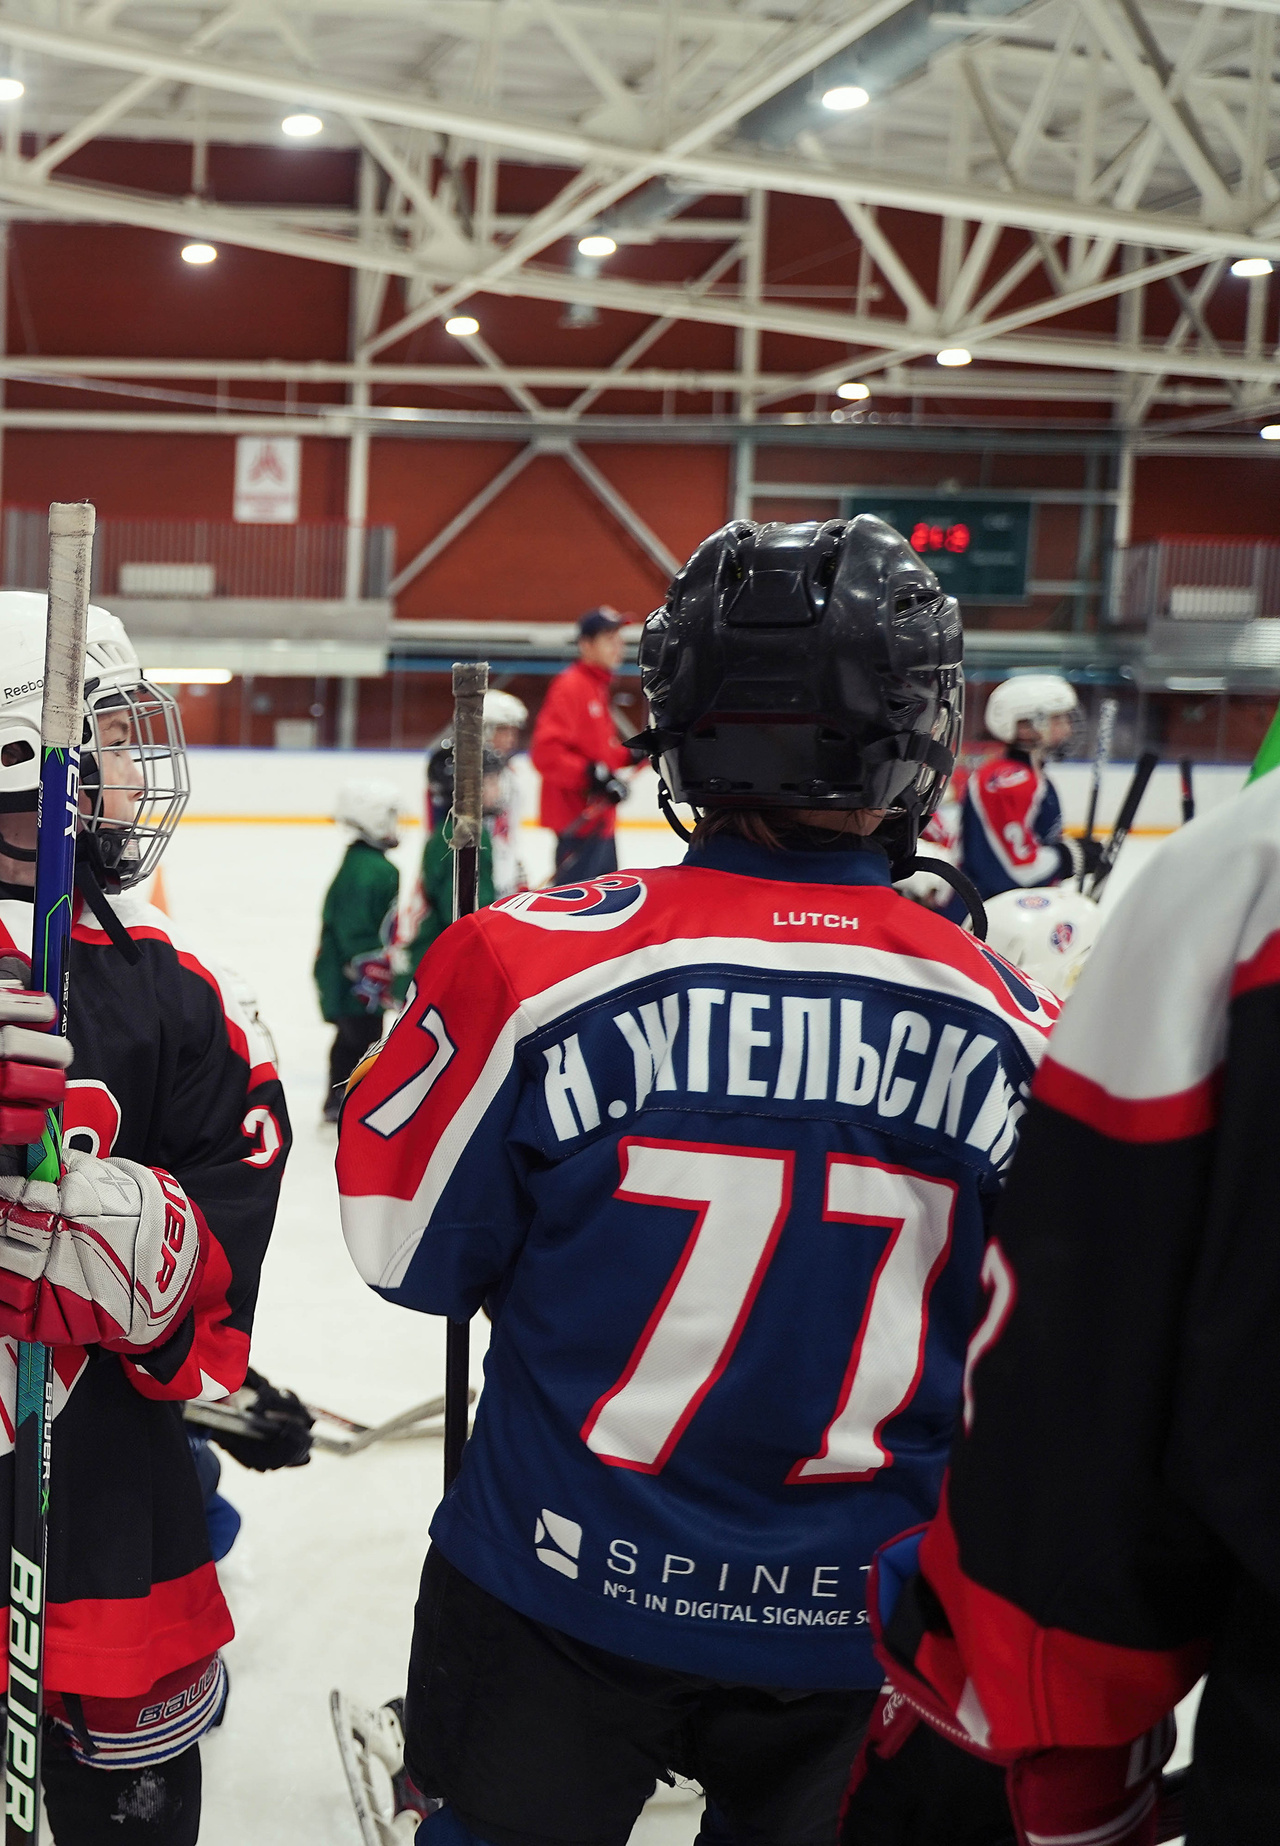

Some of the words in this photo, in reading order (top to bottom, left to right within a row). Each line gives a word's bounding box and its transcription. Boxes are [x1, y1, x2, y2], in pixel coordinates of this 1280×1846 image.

[4, 678, 44, 699] Reebo
[773, 911, 859, 930] LUTCH
[542, 987, 1028, 1168] Н.ЖГЕЛЬСКИ
[145, 1167, 188, 1294] UER
[580, 1136, 959, 1485] 77
[42, 1381, 54, 1479] BAUER
[644, 1593, 667, 1613] IN
[674, 1598, 758, 1624] DIGITAL
[762, 1606, 851, 1627] SIGNAGE
[5, 1544, 42, 1833] BAUER
